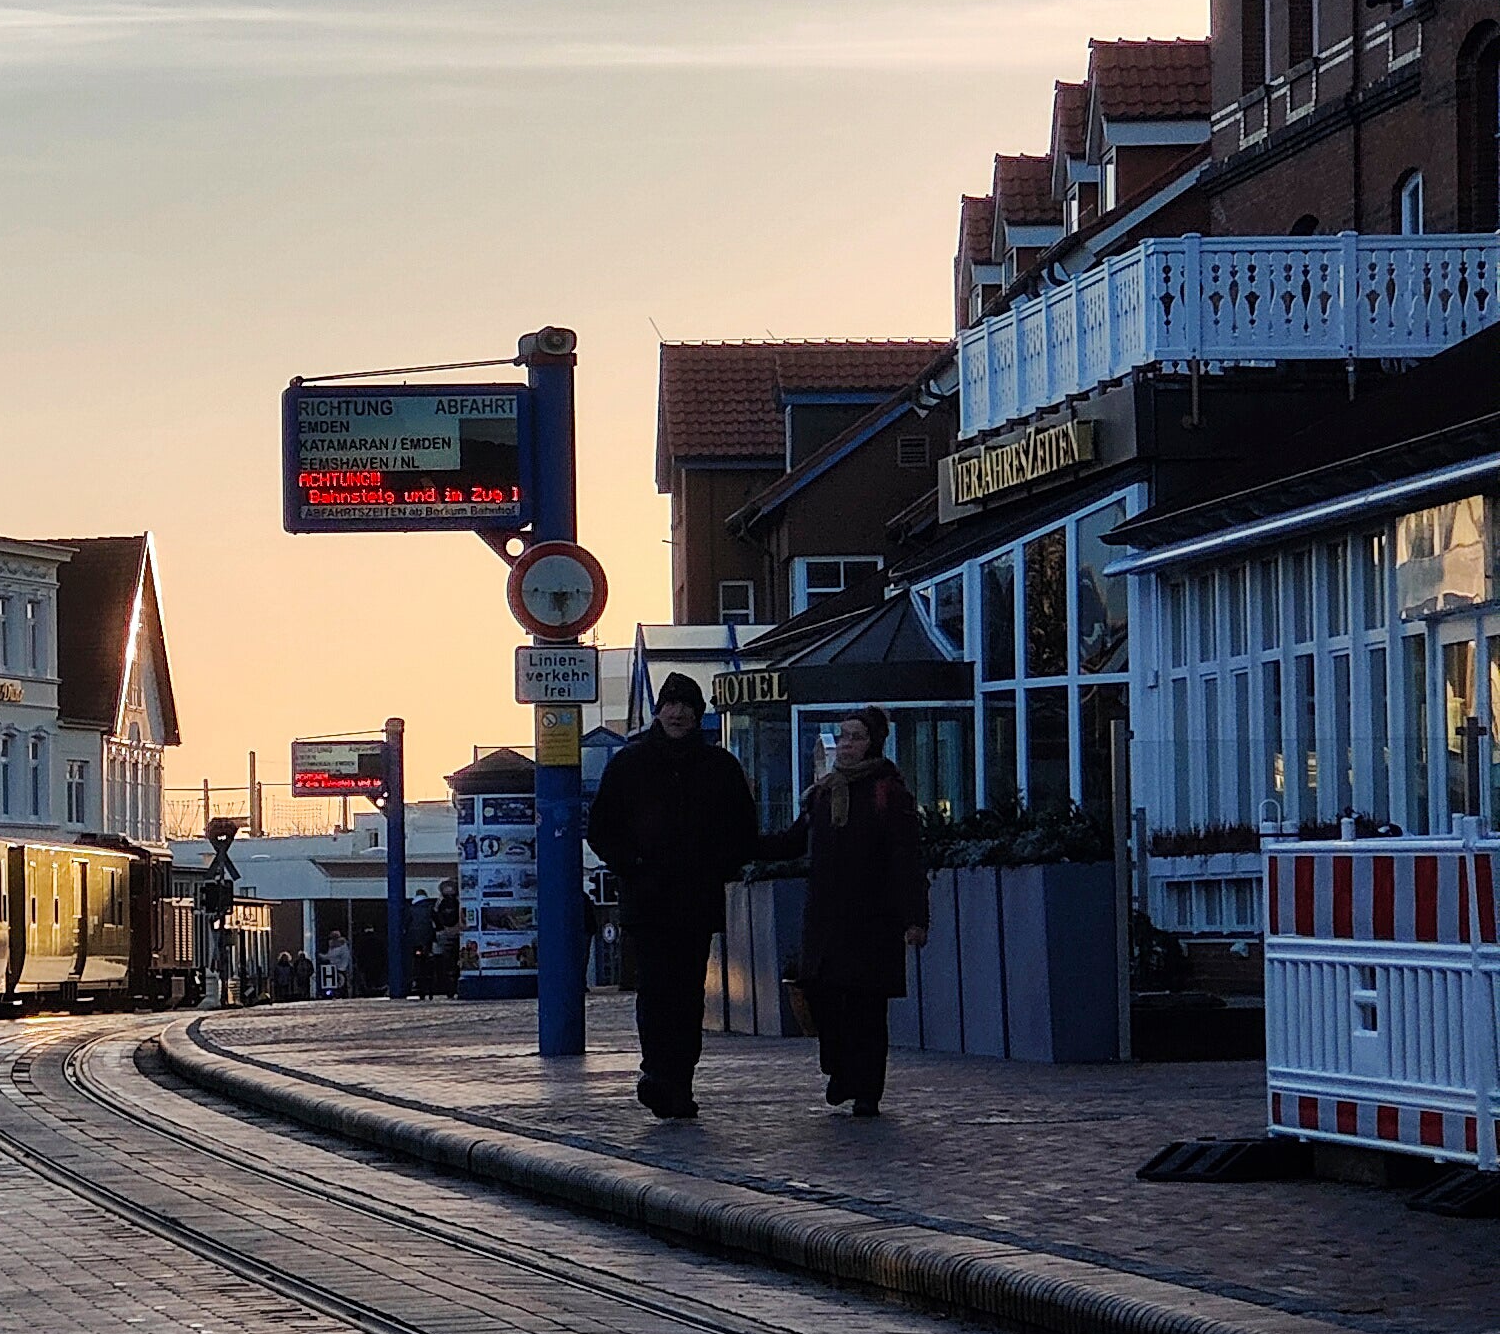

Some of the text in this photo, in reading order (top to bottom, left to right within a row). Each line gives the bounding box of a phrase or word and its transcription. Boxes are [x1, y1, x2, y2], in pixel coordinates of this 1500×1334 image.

[299, 398, 516, 416] RICHTUNG ABFAHRT
[299, 420, 349, 433] EMDEN
[300, 438, 388, 452] KATAMARAN
[401, 437, 451, 450] EMDEN
[401, 457, 419, 468] NL
[308, 488, 395, 504] Bahnsteig
[404, 488, 435, 502] und
[445, 488, 462, 502] im
[471, 487, 503, 503] Zug
[306, 507, 406, 517] ABFAHRTSZEITEN
[426, 506, 467, 517] Borkum
[529, 653, 586, 667] Linien-
[526, 669, 589, 682] verkehr
[544, 684, 571, 697] frei
[714, 672, 789, 706] HOTEL
[323, 966, 336, 987] H
